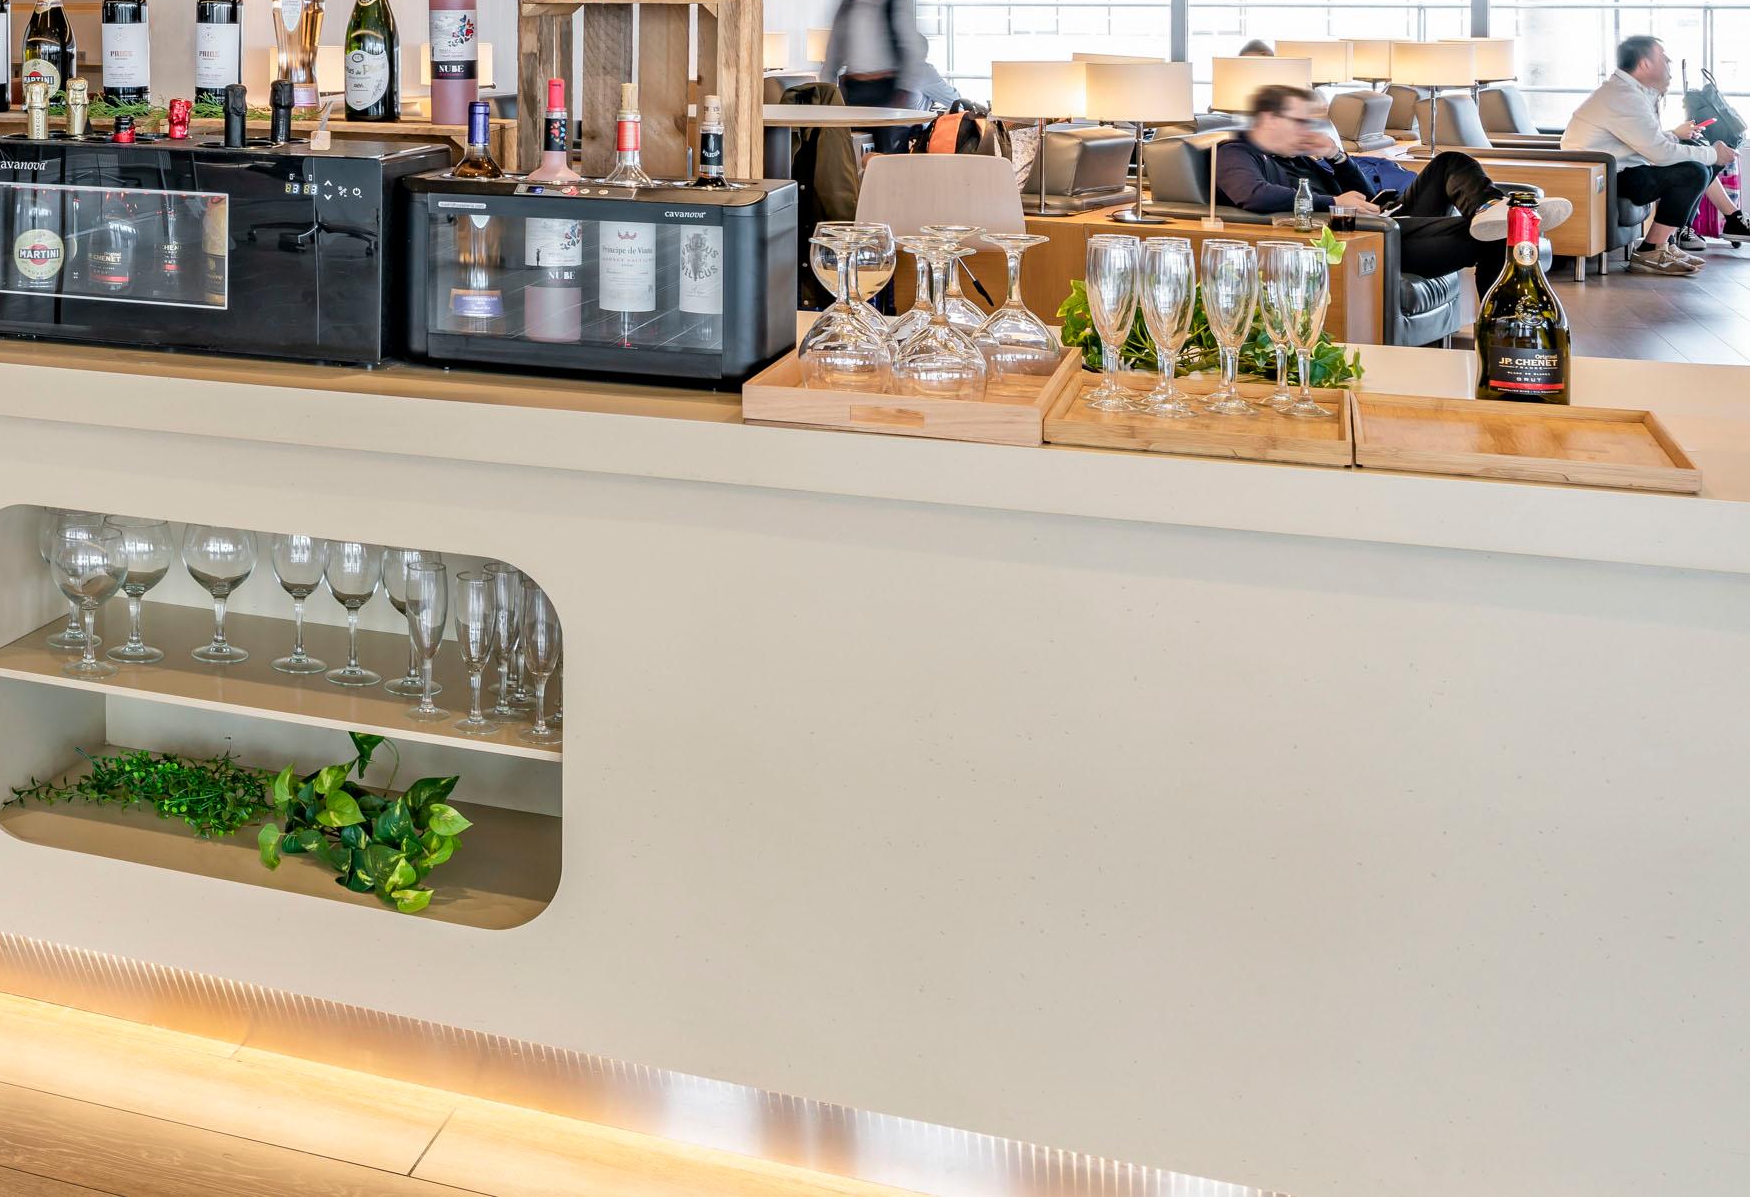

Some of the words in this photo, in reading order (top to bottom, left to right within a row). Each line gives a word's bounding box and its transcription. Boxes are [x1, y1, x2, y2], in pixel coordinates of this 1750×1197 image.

[438, 64, 464, 73] NUBE
[665, 211, 705, 219] cavanova
[19, 250, 60, 259] MARTINI
[549, 272, 575, 280] NUBE
[1515, 358, 1558, 367] CHENET
